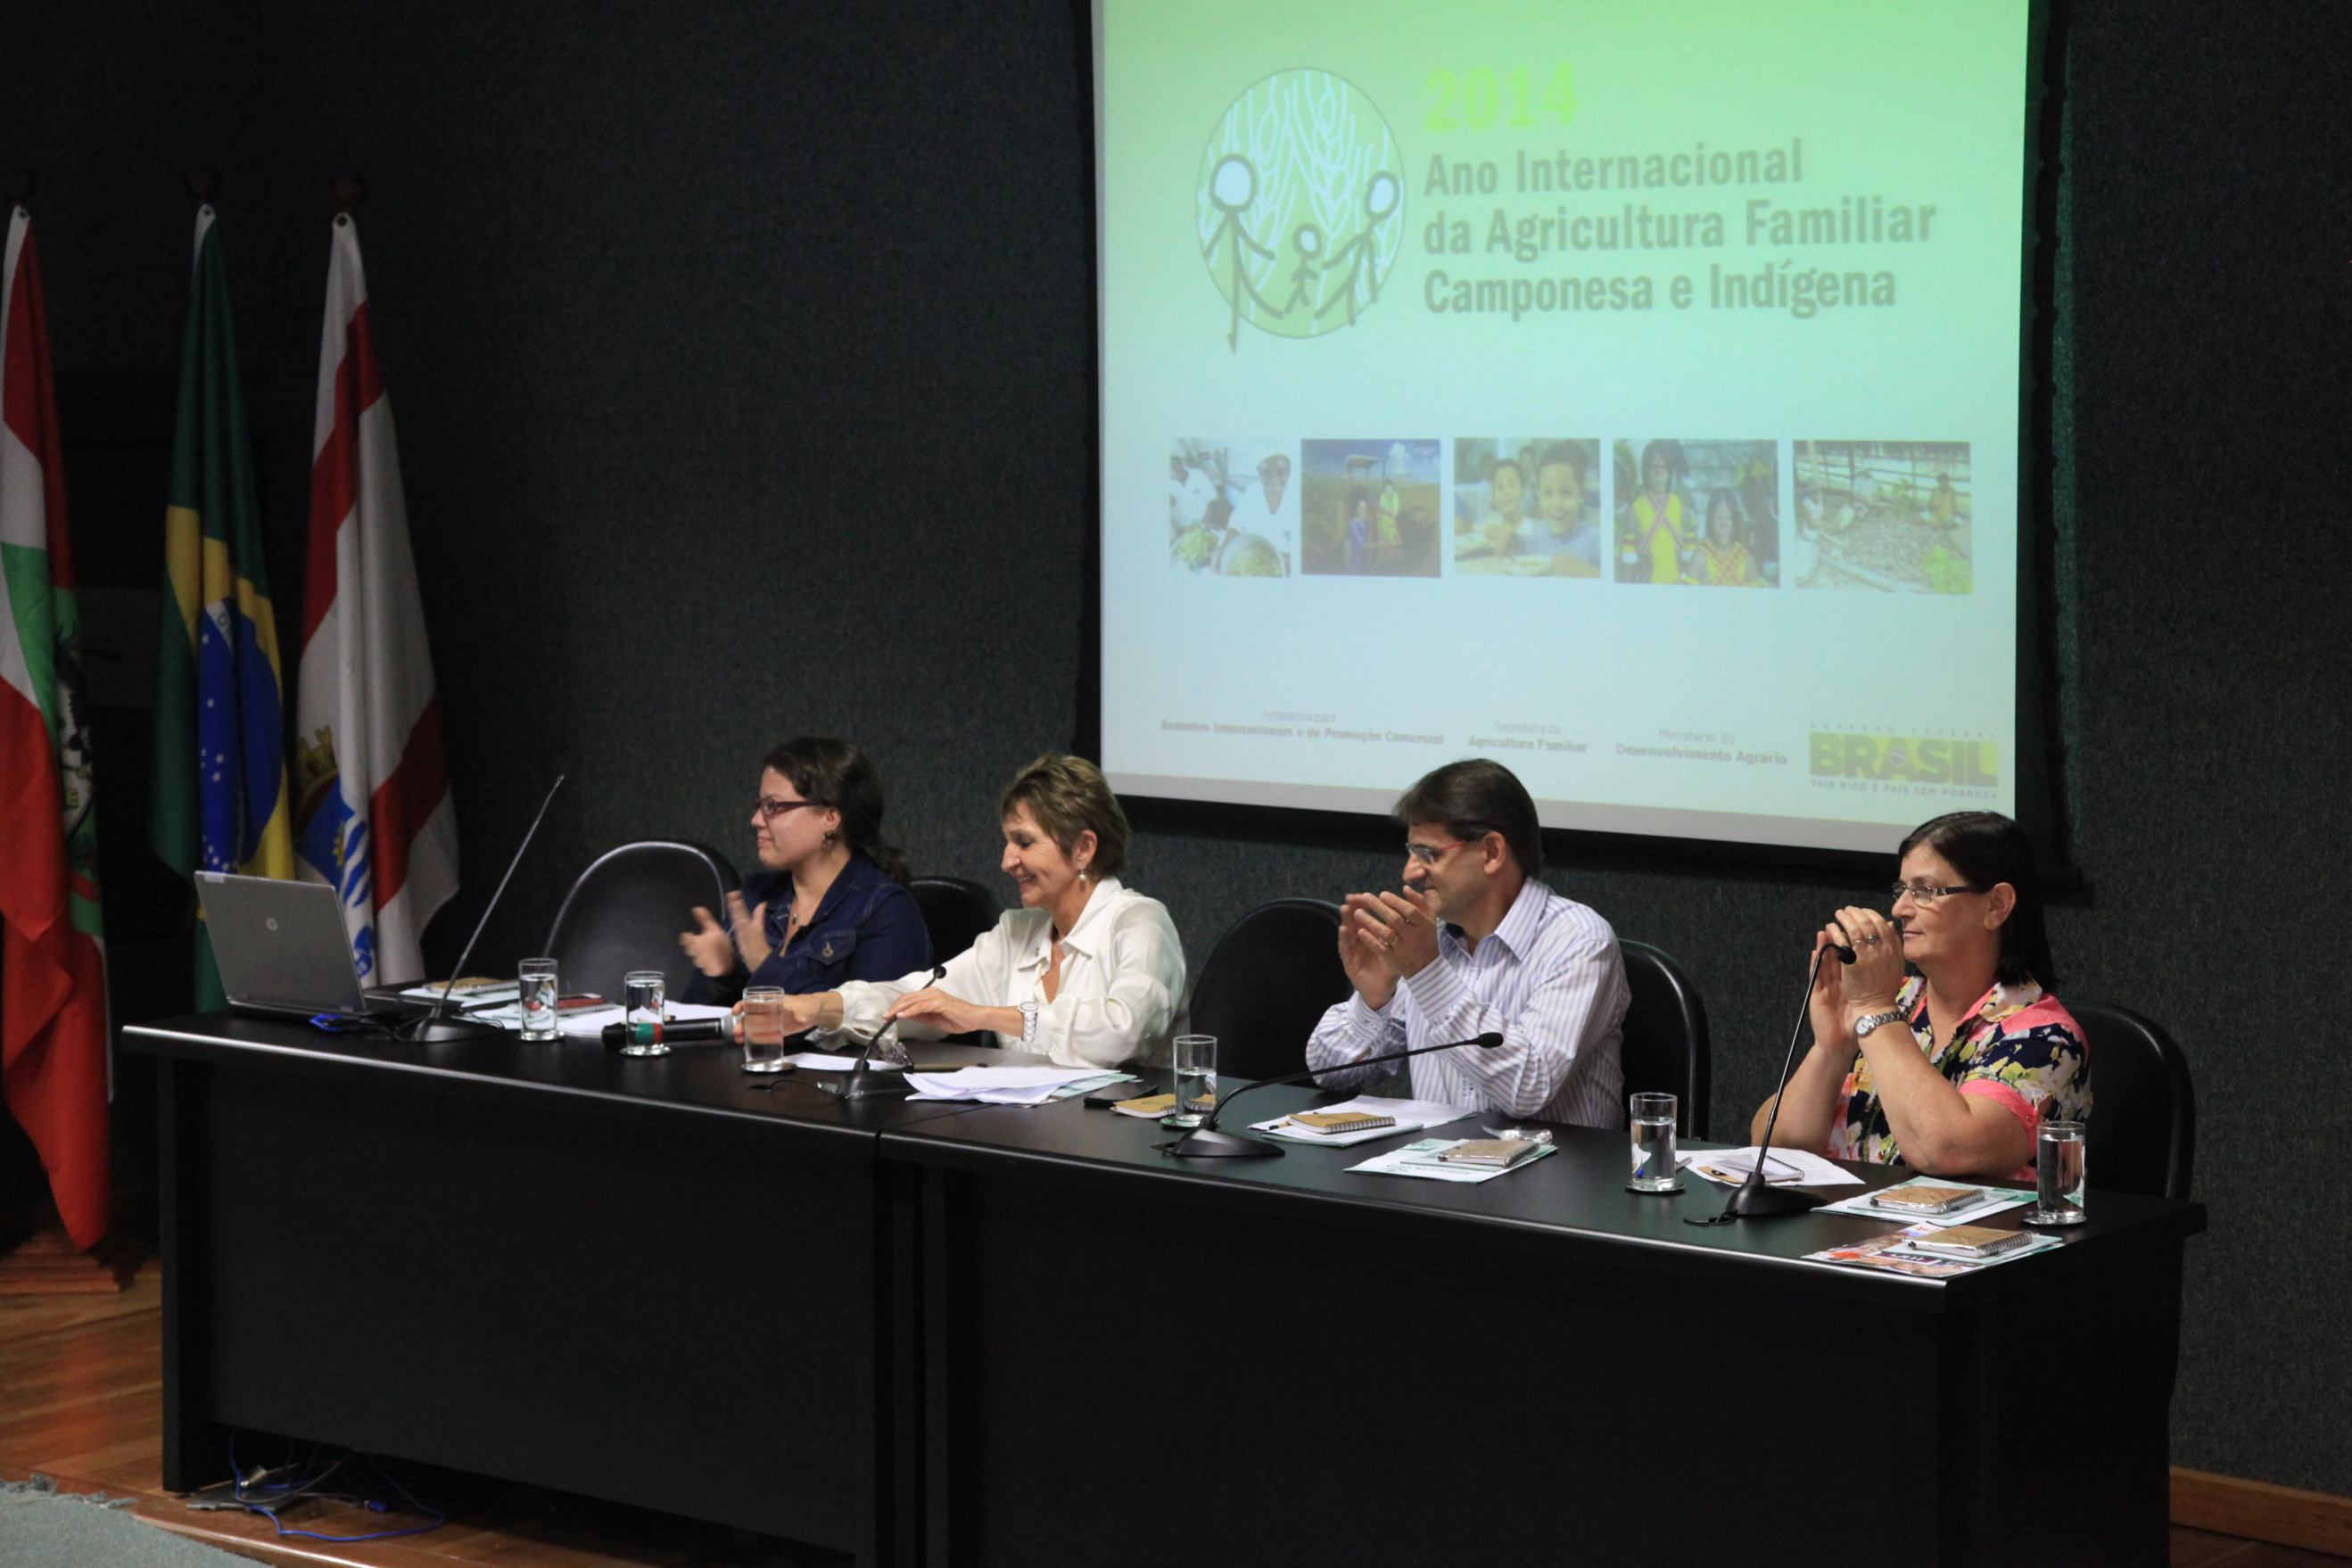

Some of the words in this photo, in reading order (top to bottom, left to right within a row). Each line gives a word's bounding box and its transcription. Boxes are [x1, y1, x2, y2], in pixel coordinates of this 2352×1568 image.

[1424, 61, 1579, 132] 2014
[1424, 153, 1498, 196] Ano
[1516, 137, 1803, 193] Internacional
[1424, 210, 1471, 254] da
[1485, 203, 1724, 263] Agricultura
[1745, 194, 1936, 247] Familiar
[1425, 268, 1653, 322] Camponesa
[1670, 274, 1693, 309] e
[1710, 258, 1896, 319] Indígena
[1160, 719, 1209, 732] Assuntos
[1213, 722, 1292, 737] Internacionais
[1307, 727, 1321, 739] de
[1325, 727, 1382, 744] Promoção
[1385, 730, 1444, 745] Comercial
[1548, 723, 1561, 735] da
[1721, 732, 1736, 745] do
[1468, 735, 1533, 750] Agricultura
[1538, 738, 1588, 753] Familiar
[1616, 742, 1731, 762] Desenvolvimento
[1809, 731, 1999, 788] BRASIL
[1840, 781, 1867, 792] RICO
[1914, 786, 1937, 796] SEM
[1943, 788, 1998, 801] POBREZA
